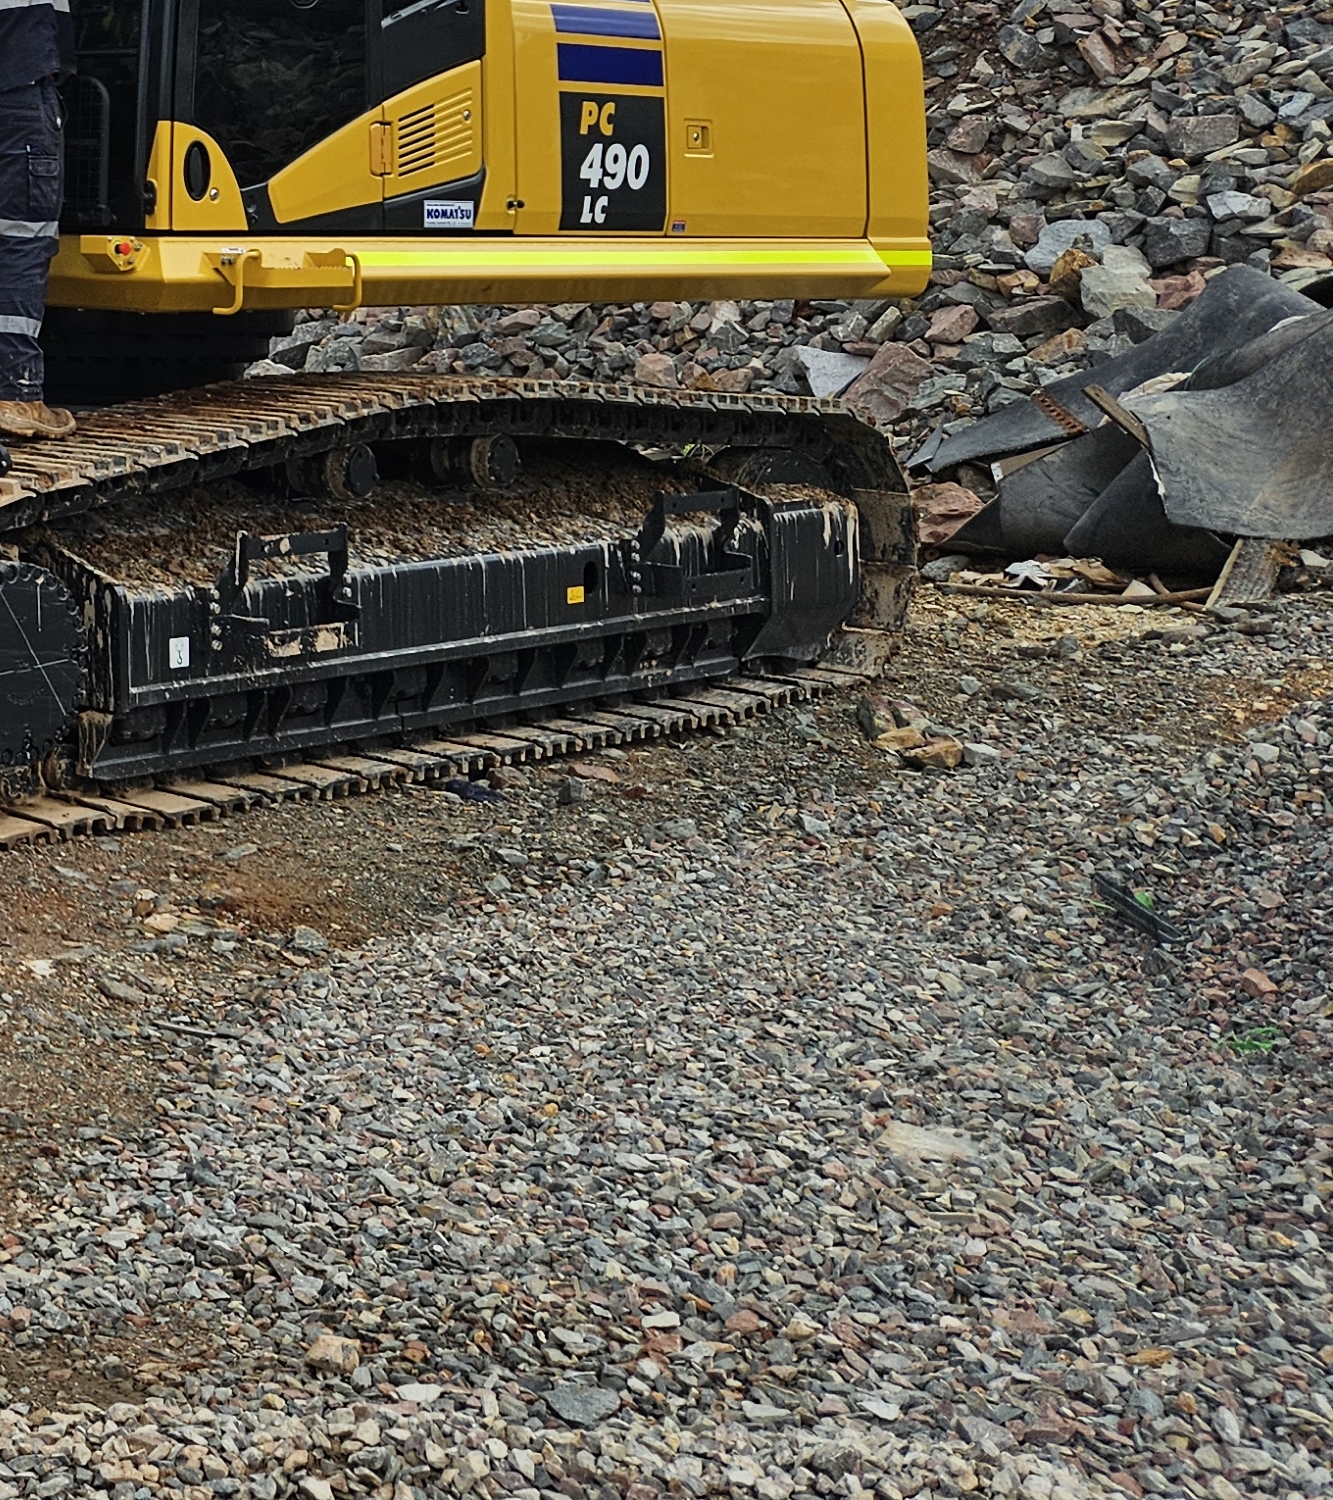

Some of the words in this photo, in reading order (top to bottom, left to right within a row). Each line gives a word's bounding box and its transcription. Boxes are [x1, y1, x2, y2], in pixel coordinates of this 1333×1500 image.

[579, 101, 616, 136] PC
[579, 143, 651, 190] 490
[426, 206, 472, 220] KOMATSU
[579, 195, 609, 224] LC
